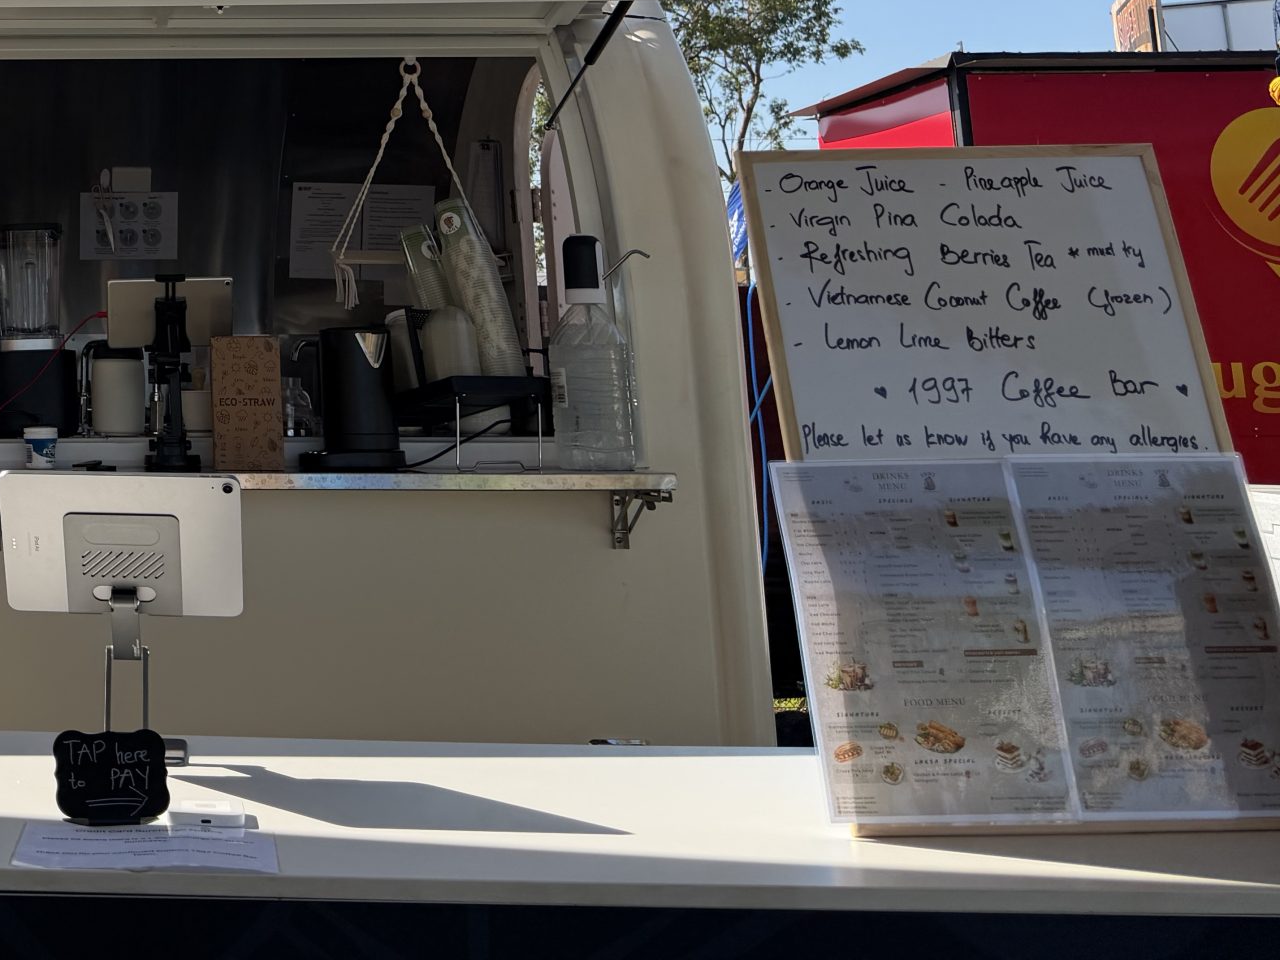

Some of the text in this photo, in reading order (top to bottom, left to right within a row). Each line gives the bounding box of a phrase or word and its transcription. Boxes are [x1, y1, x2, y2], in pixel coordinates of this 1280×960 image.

[778, 165, 1113, 203] Orange Juice Pineapple Juice
[789, 202, 1023, 237] Virgin Pina Colada
[799, 239, 1146, 277] Refreshing Berries Tea must try
[807, 278, 912, 309] Vietnamese
[924, 281, 988, 311] Coconut
[1005, 281, 1062, 321] Coffee
[824, 322, 1036, 352] Lemon Lime Bitters
[908, 369, 1159, 408] 1997 Coffee Bar
[219, 397, 276, 408] ECO-STRAW
[801, 421, 850, 455] Please
[861, 424, 884, 447] let
[896, 432, 912, 447] us
[924, 425, 969, 449] know
[981, 429, 996, 452] if
[1001, 432, 1031, 453] you
[1039, 421, 1082, 446] have
[1090, 434, 1118, 454] any
[872, 471, 912, 481] DRINKS
[877, 481, 906, 491] MENU
[1107, 469, 1144, 478] DRINKS
[1113, 479, 1141, 488] MENU
[903, 696, 966, 707] FOOD MENU
[63, 740, 151, 766] TAP here
[68, 765, 150, 791] to PAY
